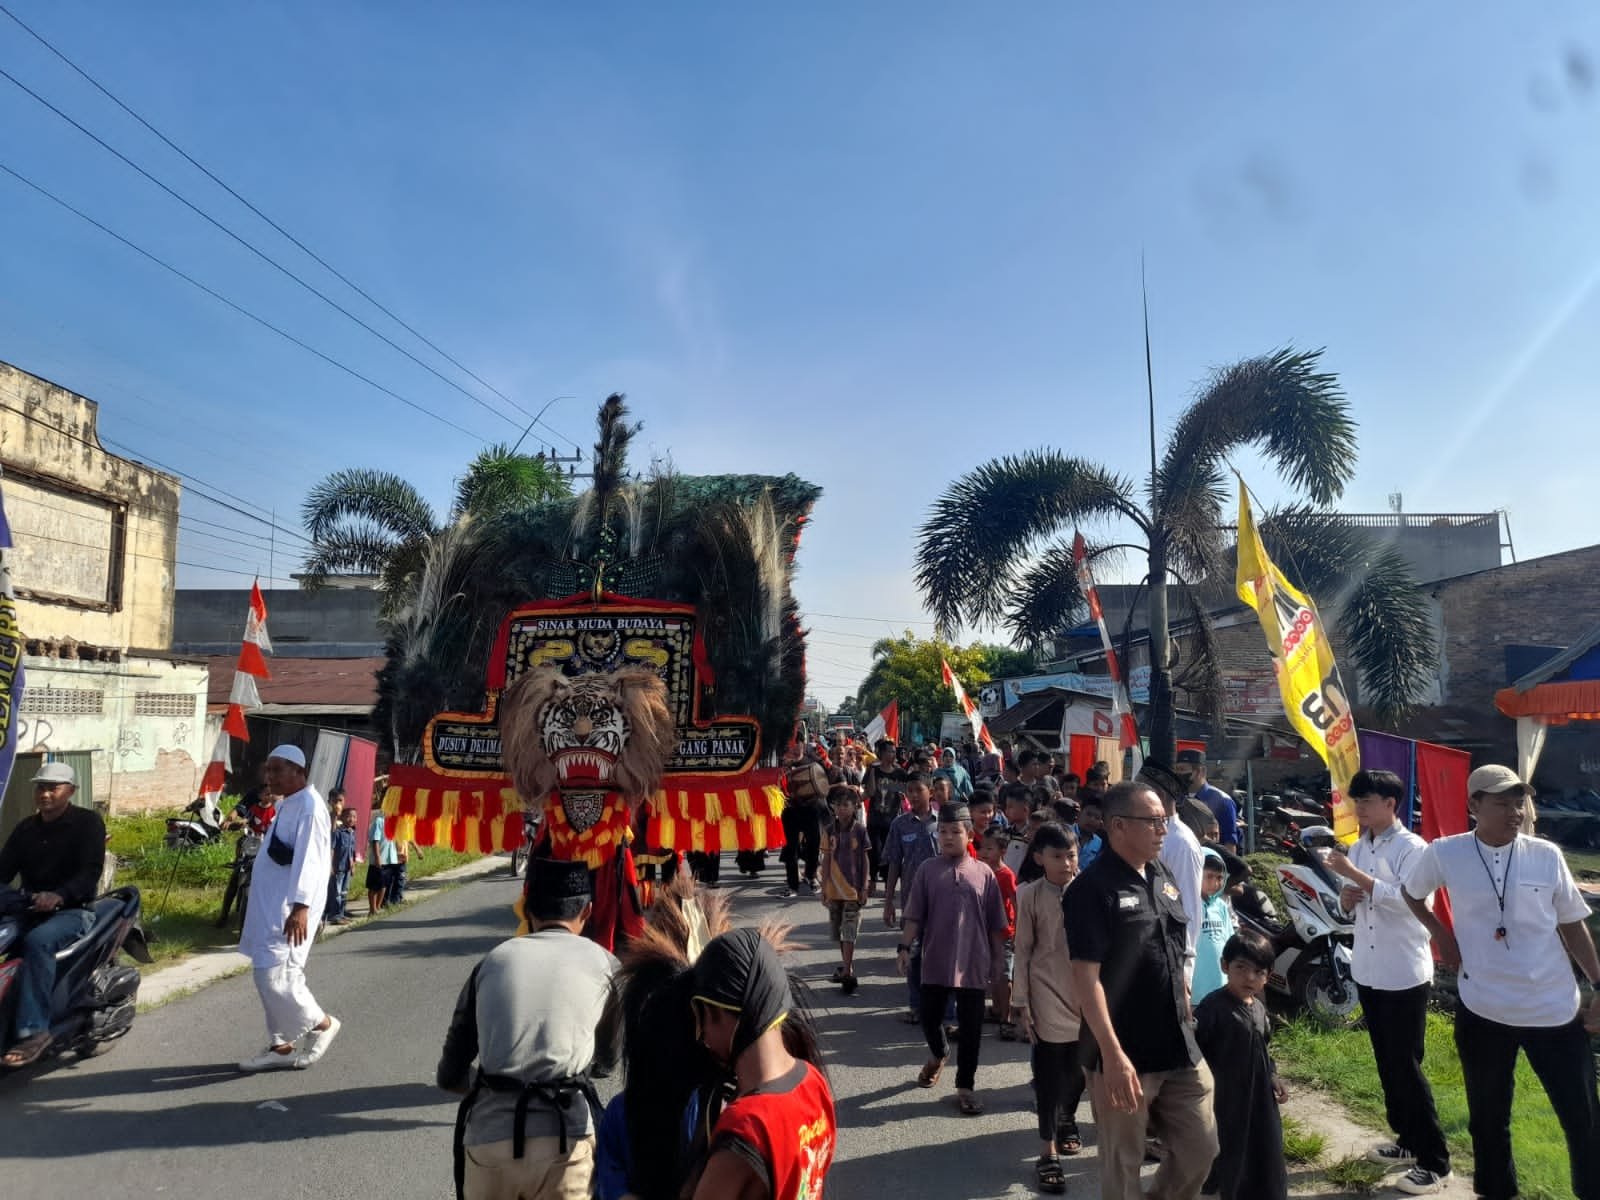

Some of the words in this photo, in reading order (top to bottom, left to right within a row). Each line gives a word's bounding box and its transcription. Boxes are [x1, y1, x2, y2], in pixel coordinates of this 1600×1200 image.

[537, 619, 575, 630] SINAR
[577, 619, 613, 630] MUDA
[617, 618, 665, 629] BUDAYA
[438, 736, 468, 752] DUSUN
[679, 740, 708, 755] GANG
[711, 739, 746, 755] PANAK
